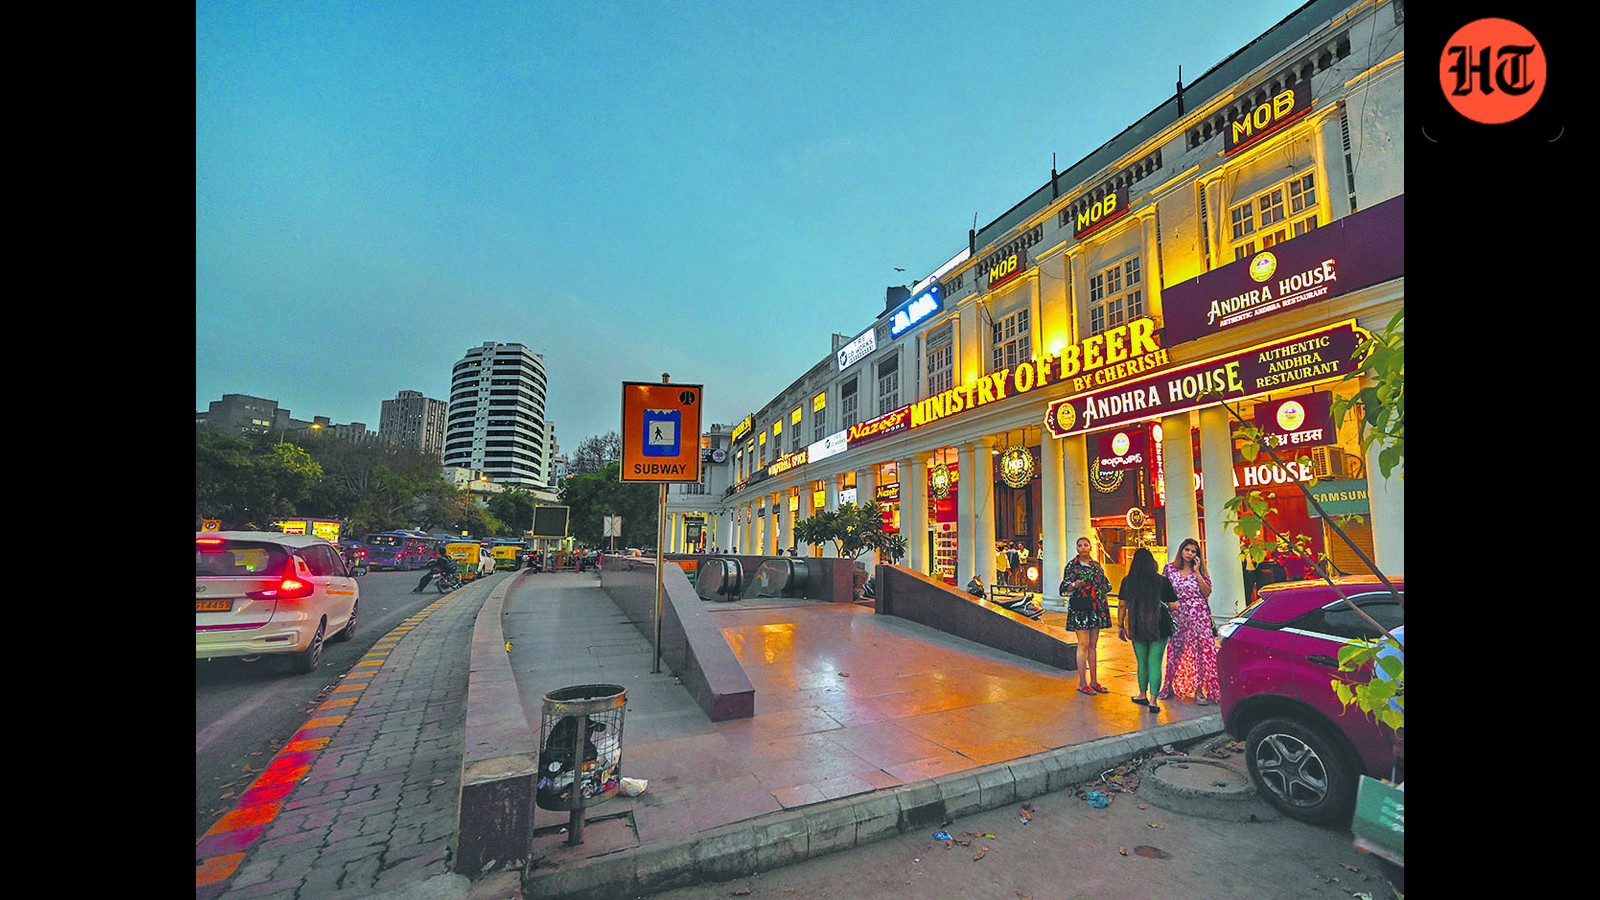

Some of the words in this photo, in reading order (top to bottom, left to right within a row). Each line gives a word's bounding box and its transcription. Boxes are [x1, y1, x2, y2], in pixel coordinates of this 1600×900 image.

[1231, 88, 1296, 145] MOB
[1077, 193, 1117, 232] MOB
[989, 254, 1018, 284] MOB
[1207, 286, 1272, 325] ANDHRA
[1279, 258, 1337, 296] HOUSE
[1282, 287, 1329, 308] RESTAURANT
[1258, 336, 1331, 363] AUTHENTIC
[1268, 352, 1322, 373] ANDHRA
[911, 368, 1009, 427] MINISTRY
[1014, 352, 1053, 392] OF
[1060, 317, 1160, 379] BEER
[1073, 374, 1092, 392] BY
[1095, 350, 1170, 385] CHERISH
[1256, 360, 1339, 389] RESTAURANT
[1082, 385, 1161, 429] ANDHRA
[1168, 360, 1245, 403] HOUSE
[847, 412, 905, 442] Nazeer
[881, 423, 905, 434] FOODS
[1290, 429, 1323, 443] हाउस
[634, 463, 687, 475] SUBWAY
[1155, 442, 1166, 507] RESTAURANT
[1244, 461, 1314, 487] HOUSE
[1312, 490, 1370, 503] SAMSUN
